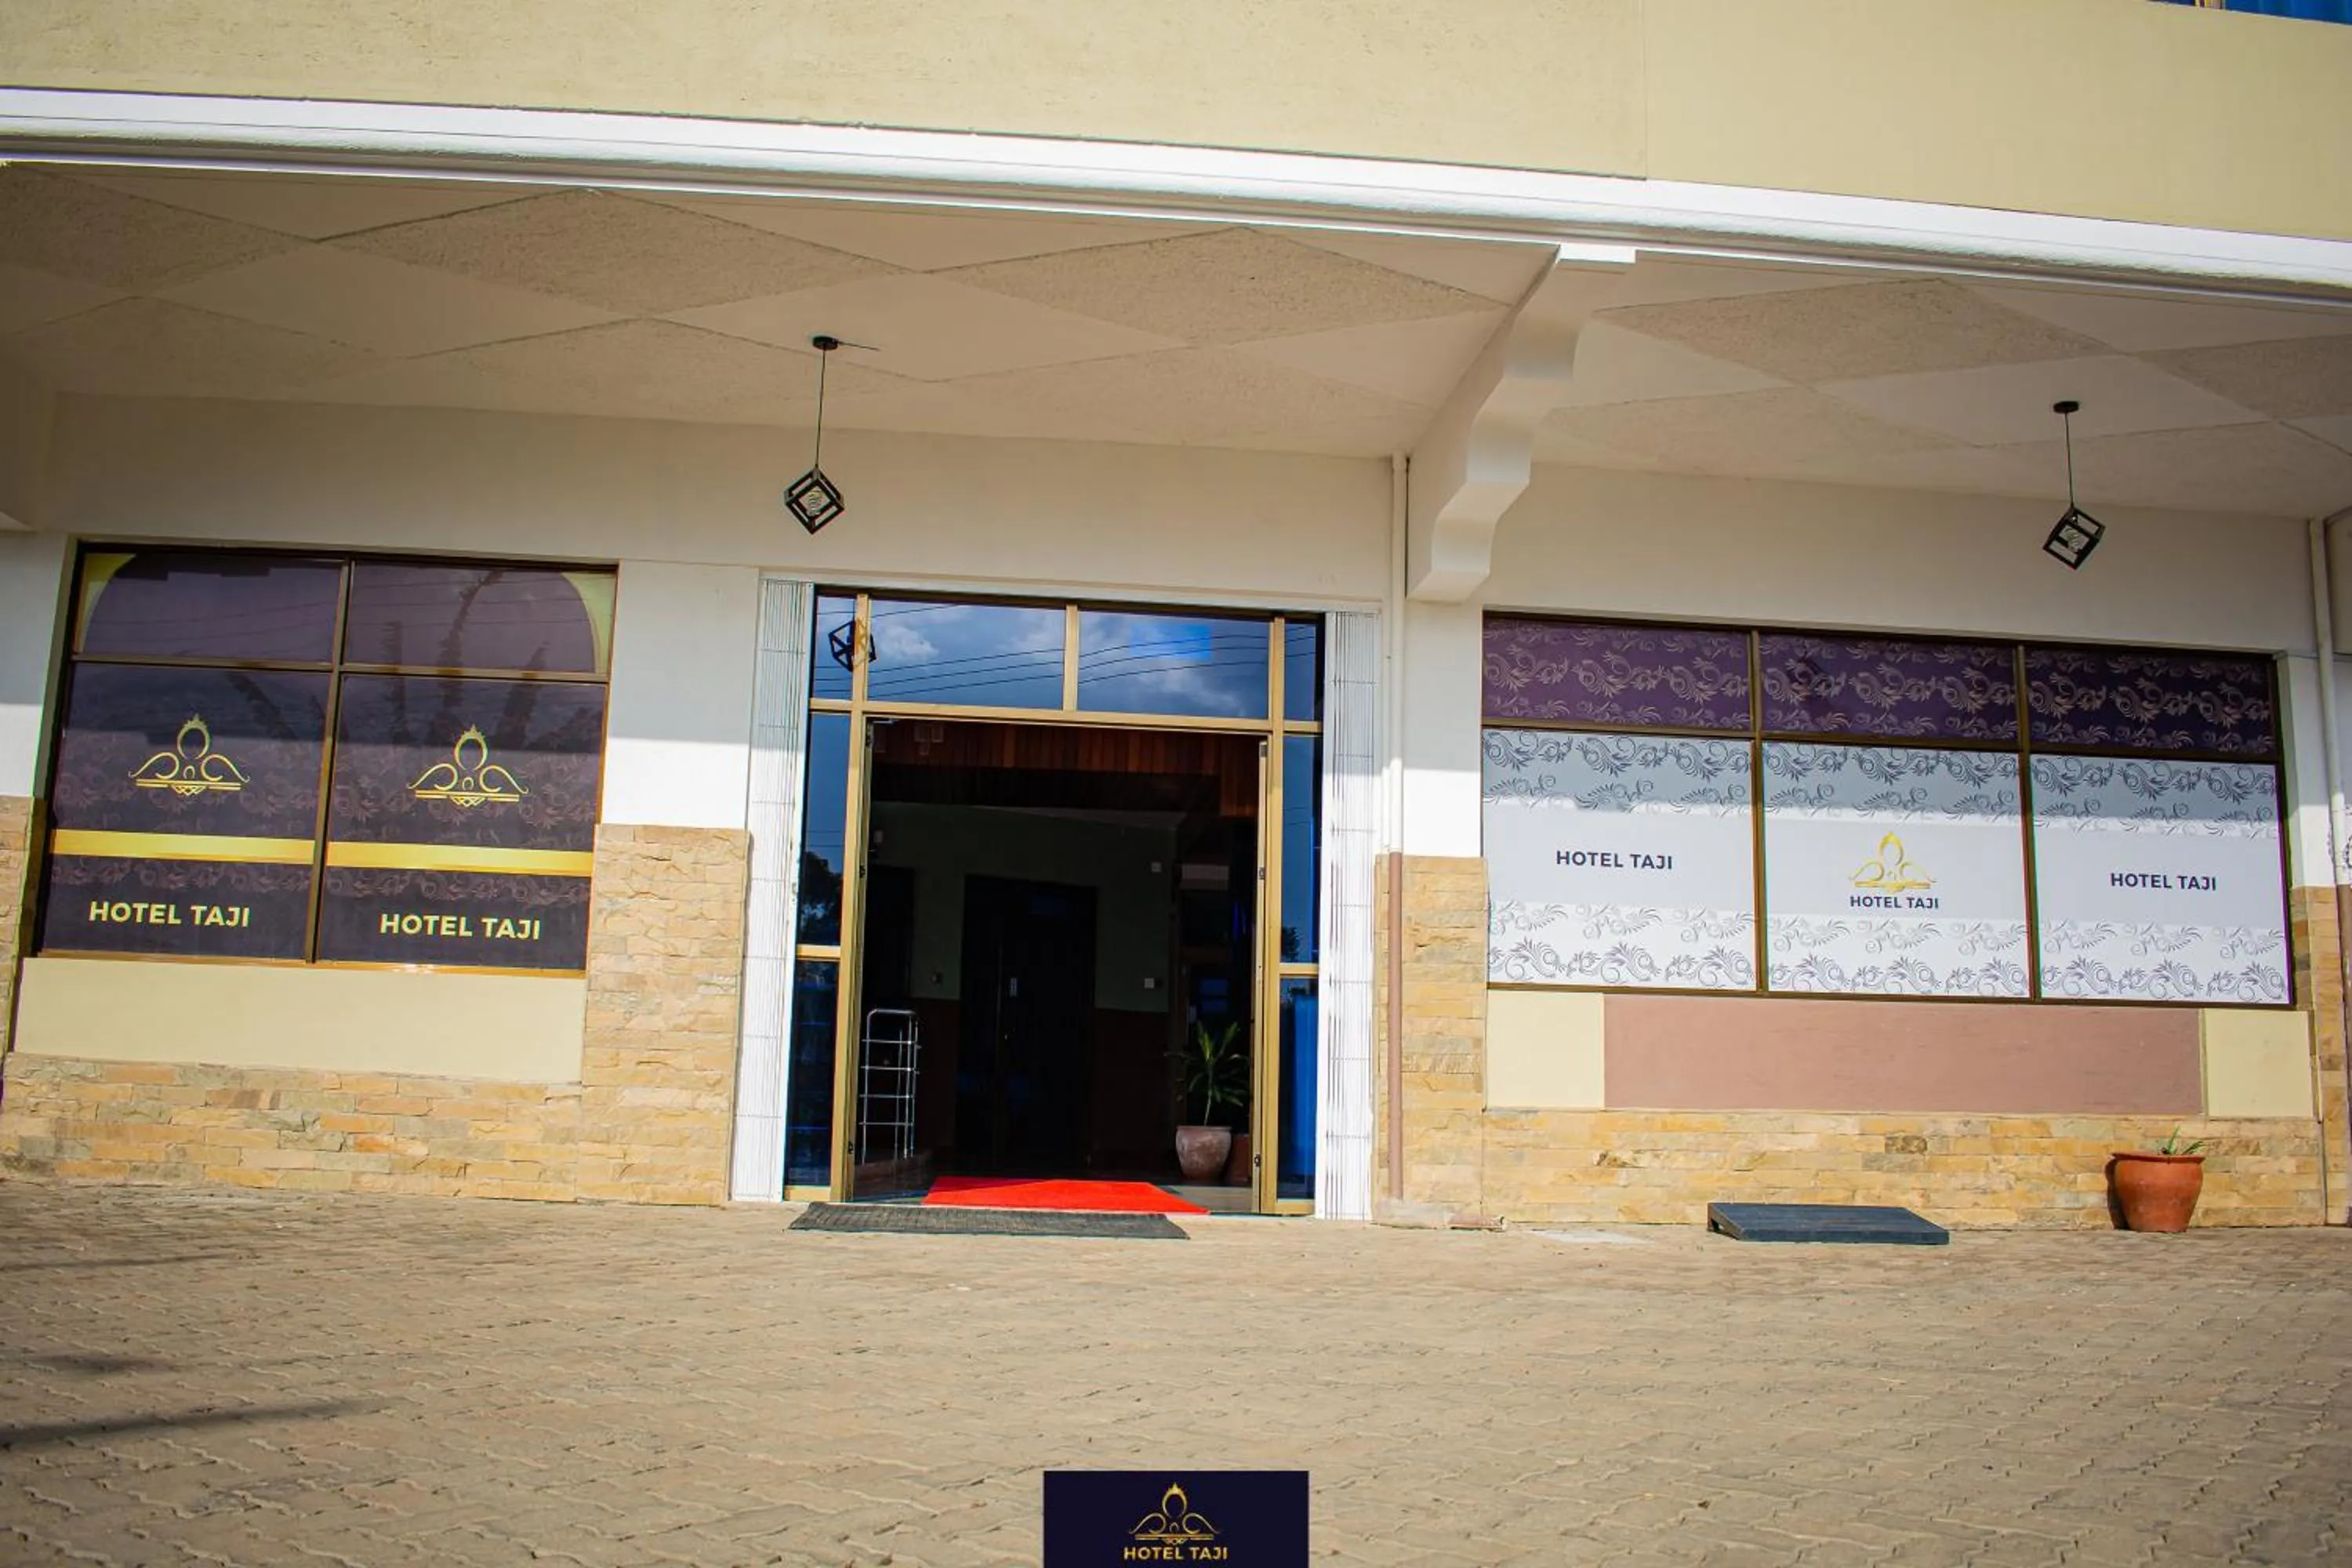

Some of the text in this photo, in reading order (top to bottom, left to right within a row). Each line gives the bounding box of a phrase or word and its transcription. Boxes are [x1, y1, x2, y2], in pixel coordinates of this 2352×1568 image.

[1556, 851, 1673, 870] HOTEL TAJI
[2111, 873, 2217, 891] HOTEL TAJI
[1850, 896, 1939, 909] HOTEL TAJI
[89, 901, 250, 927] HOTEL TAJI
[380, 913, 541, 940] HOTEL TAJI
